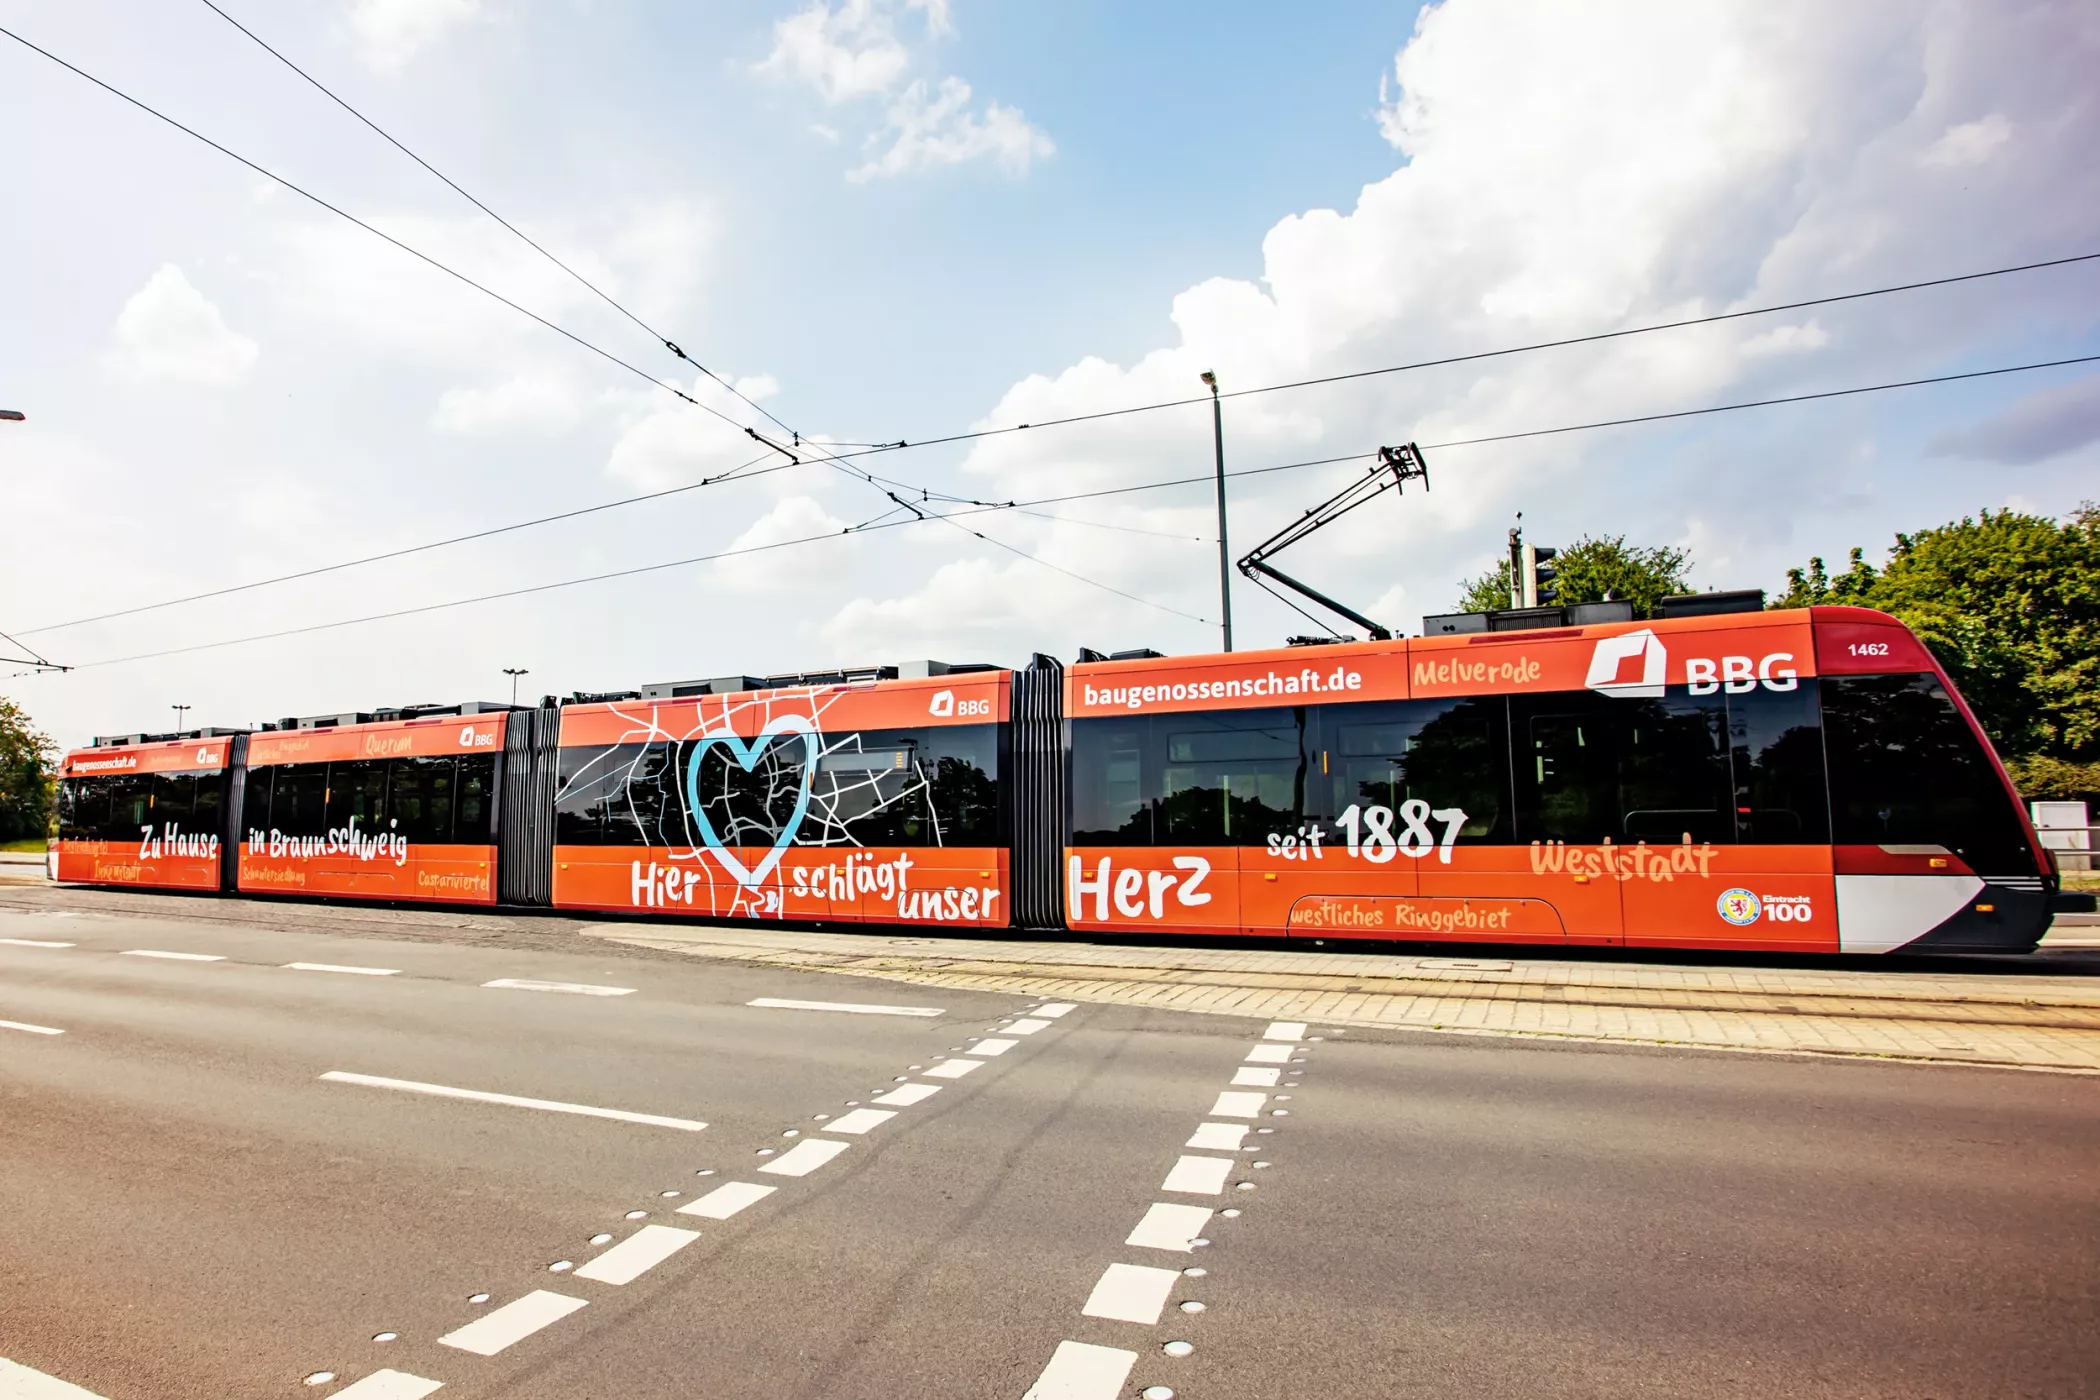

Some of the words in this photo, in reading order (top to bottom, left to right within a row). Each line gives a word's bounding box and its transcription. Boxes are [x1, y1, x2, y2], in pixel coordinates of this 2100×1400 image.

[1848, 643, 1889, 656] 1462
[1084, 666, 1362, 709] baugenossenschaft.de
[1414, 656, 1541, 687] Melverode
[1686, 652, 1798, 696] BBG
[957, 699, 990, 717] BBG
[365, 733, 412, 756] Querum
[474, 733, 493, 746] BBG
[72, 755, 137, 773] baugenossenschaft.de
[139, 824, 161, 860] Zu
[164, 821, 219, 860] Hause
[248, 827, 265, 856] in
[269, 815, 407, 867] Braunschweig
[1267, 824, 1326, 861] seit
[1335, 799, 1469, 864] 1887
[1530, 832, 1718, 882] Weststadt
[632, 860, 701, 908] Hier
[791, 852, 914, 901] schlägt
[898, 887, 1001, 921] unser
[1068, 855, 1212, 922] Herz
[1762, 894, 1811, 904] Eintracht
[1290, 900, 1384, 928] westliches
[1395, 901, 1512, 932] Ringgebiet
[1763, 904, 1812, 922] 100
